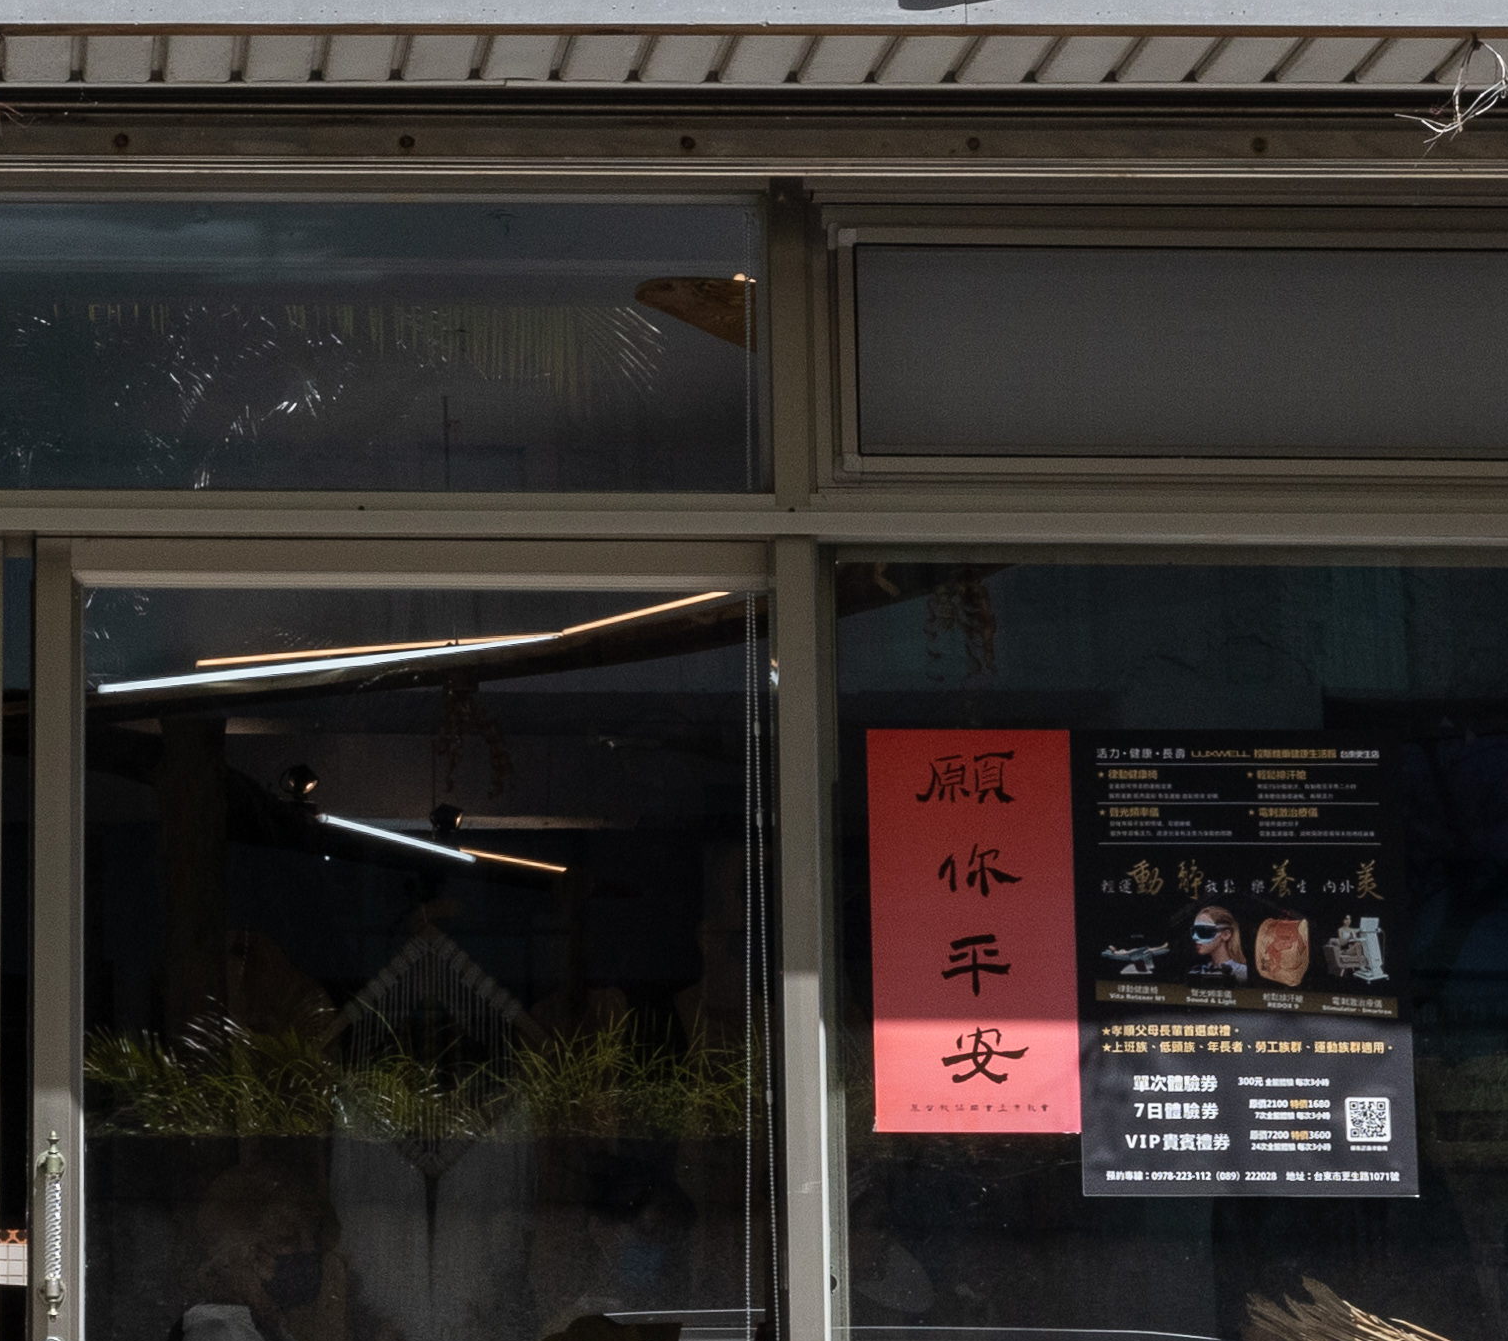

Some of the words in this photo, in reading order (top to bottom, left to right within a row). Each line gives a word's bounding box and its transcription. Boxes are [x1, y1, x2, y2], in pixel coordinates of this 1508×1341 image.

[915, 750, 1030, 1084] 願你平安
[1133, 1075, 1218, 1093] 單次體驗券
[1238, 1076, 1264, 1087] 300元
[1134, 1102, 1219, 1120] 7日體驗券
